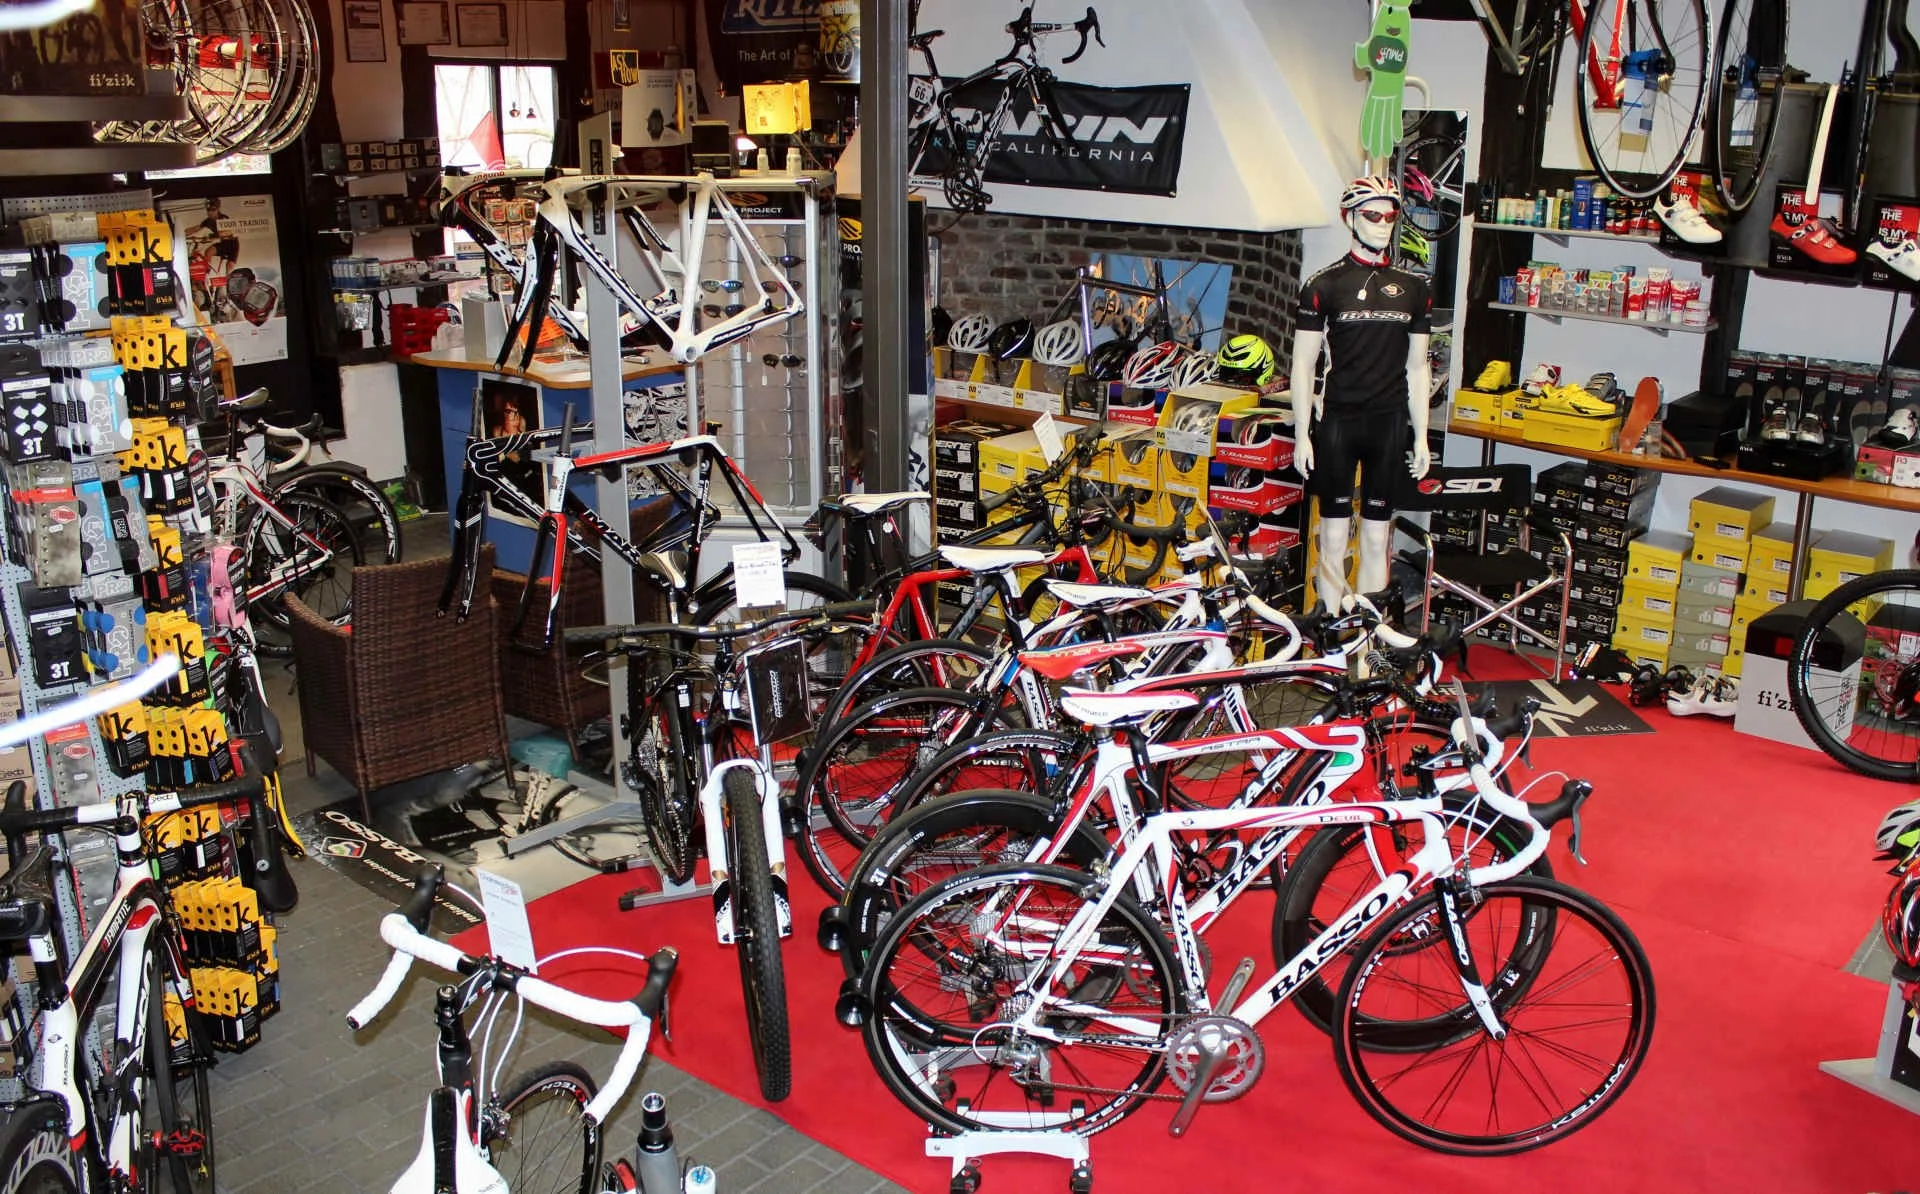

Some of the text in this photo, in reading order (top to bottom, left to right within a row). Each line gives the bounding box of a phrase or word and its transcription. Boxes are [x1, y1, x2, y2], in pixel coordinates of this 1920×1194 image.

[914, 86, 926, 100] 66
[1880, 210, 1903, 221] THE
[1890, 228, 1908, 240] MY
[4, 313, 25, 331] 3T
[23, 437, 43, 455] 3T
[51, 661, 70, 679] 3T
[870, 868, 888, 887] 3T
[1268, 892, 1389, 1006] BASSO
